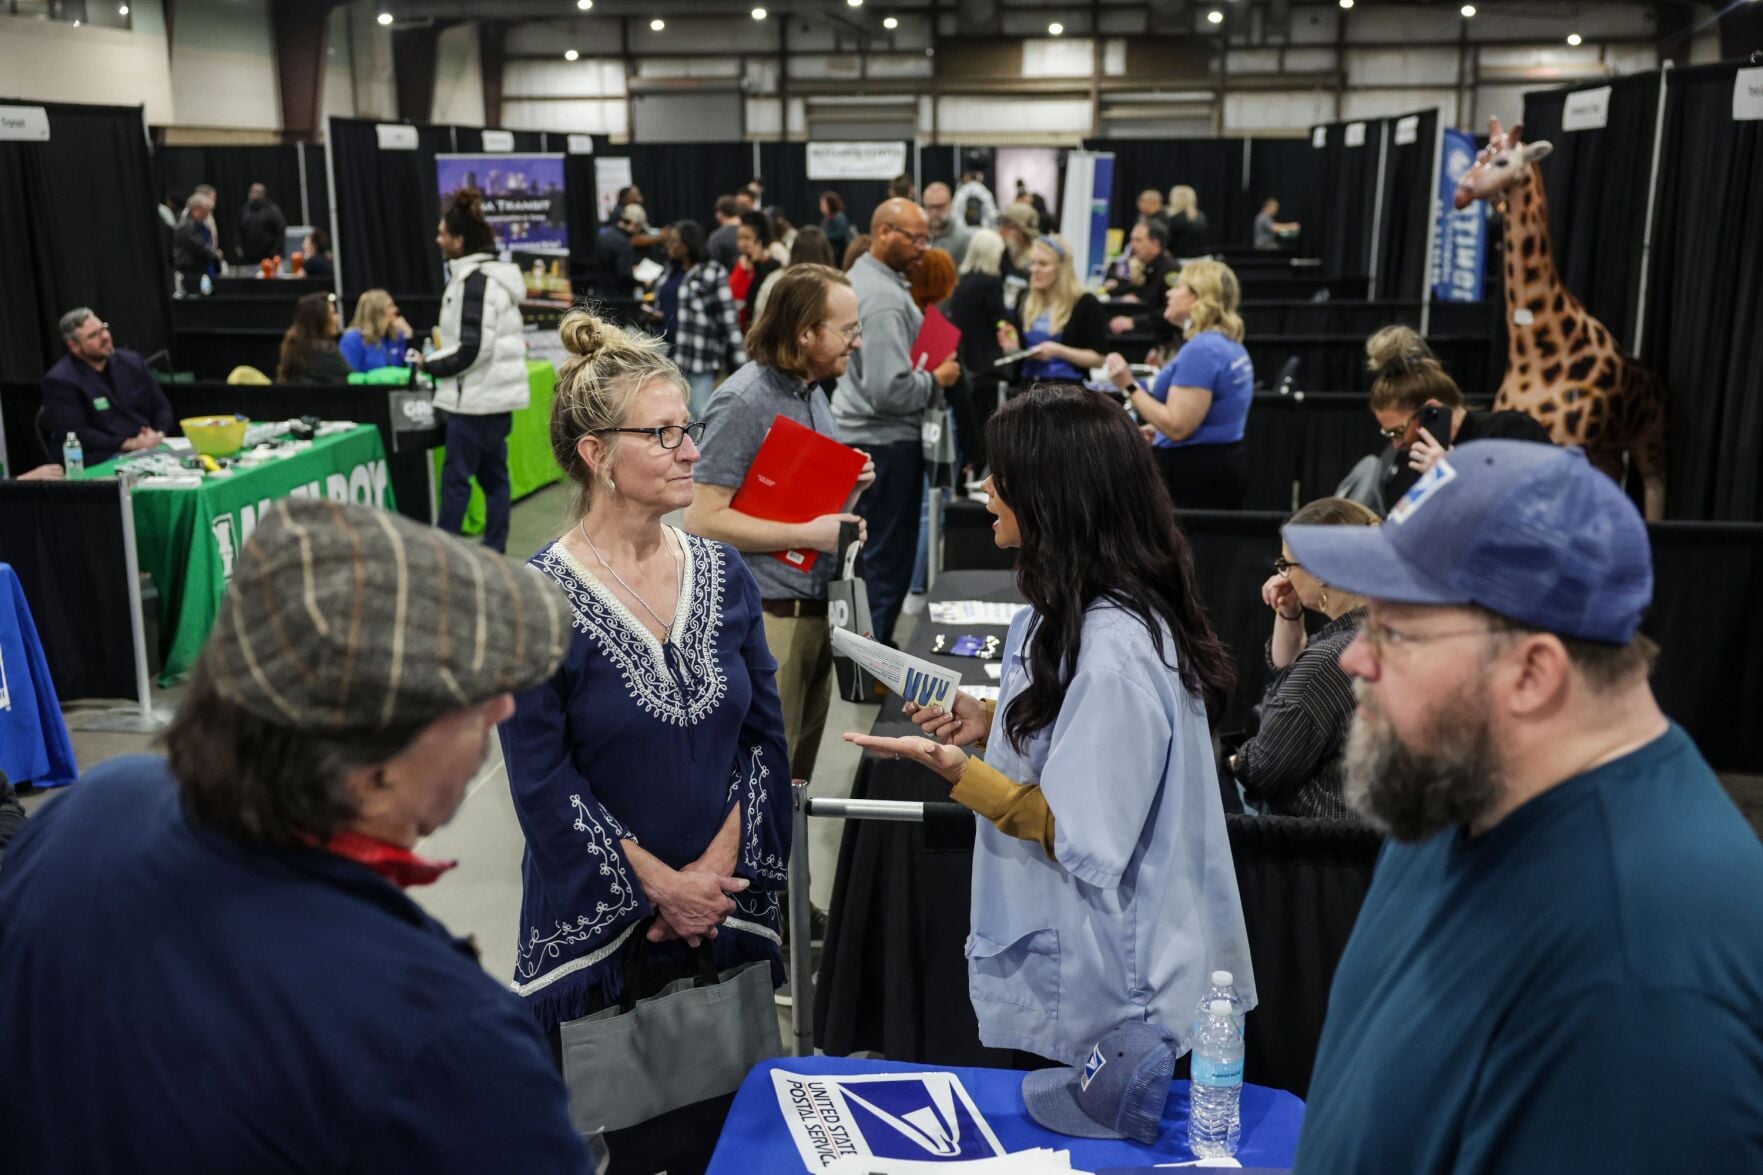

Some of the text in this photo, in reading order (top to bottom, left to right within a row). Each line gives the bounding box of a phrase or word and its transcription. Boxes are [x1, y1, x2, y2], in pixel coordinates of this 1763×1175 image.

[786, 1079, 817, 1122] POSTAL
[808, 1081, 858, 1155] UNITED STATE
